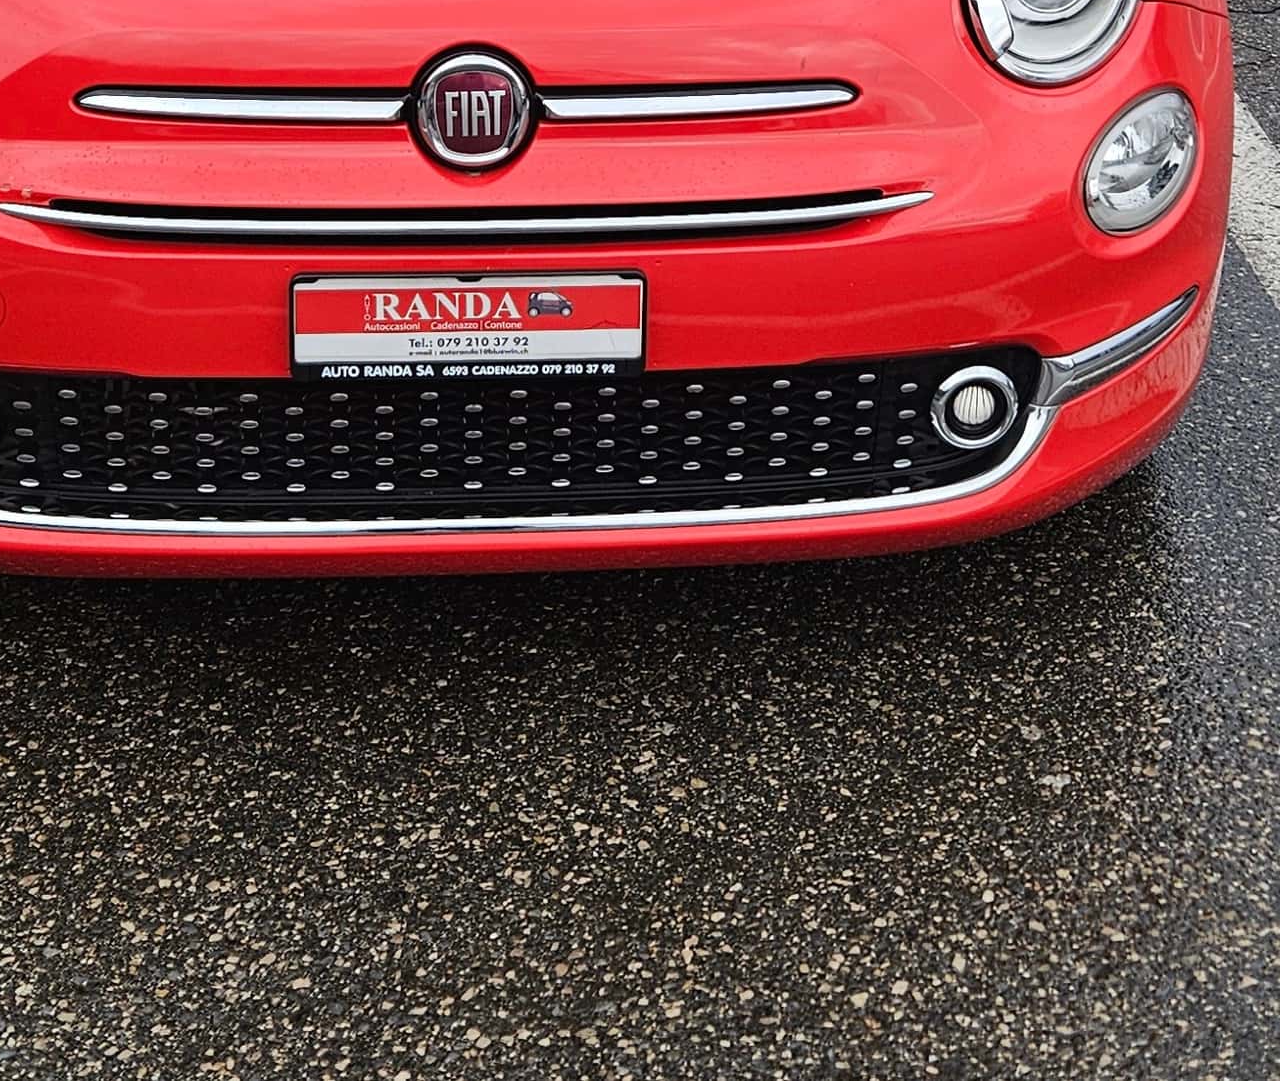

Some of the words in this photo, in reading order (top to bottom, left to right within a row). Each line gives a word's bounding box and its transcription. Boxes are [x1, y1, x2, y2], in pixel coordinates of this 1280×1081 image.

[444, 90, 506, 137] FIAT
[372, 291, 523, 321] RANDA
[430, 321, 479, 330] Cadenazzo
[484, 320, 522, 330] Contone
[408, 338, 433, 348] Tel.:
[437, 337, 461, 347] 079
[465, 337, 489, 347] 210
[493, 337, 509, 346] 37
[513, 336, 529, 346] 92
[321, 366, 360, 378] AUTO
[364, 365, 413, 377] RANDA
[416, 364, 435, 377] SA
[442, 365, 469, 376] 6593
[471, 365, 539, 375] CADENAZZO
[541, 364, 562, 375] 079
[564, 364, 583, 375] 210
[585, 364, 599, 374] 37
[601, 363, 616, 374] 92
